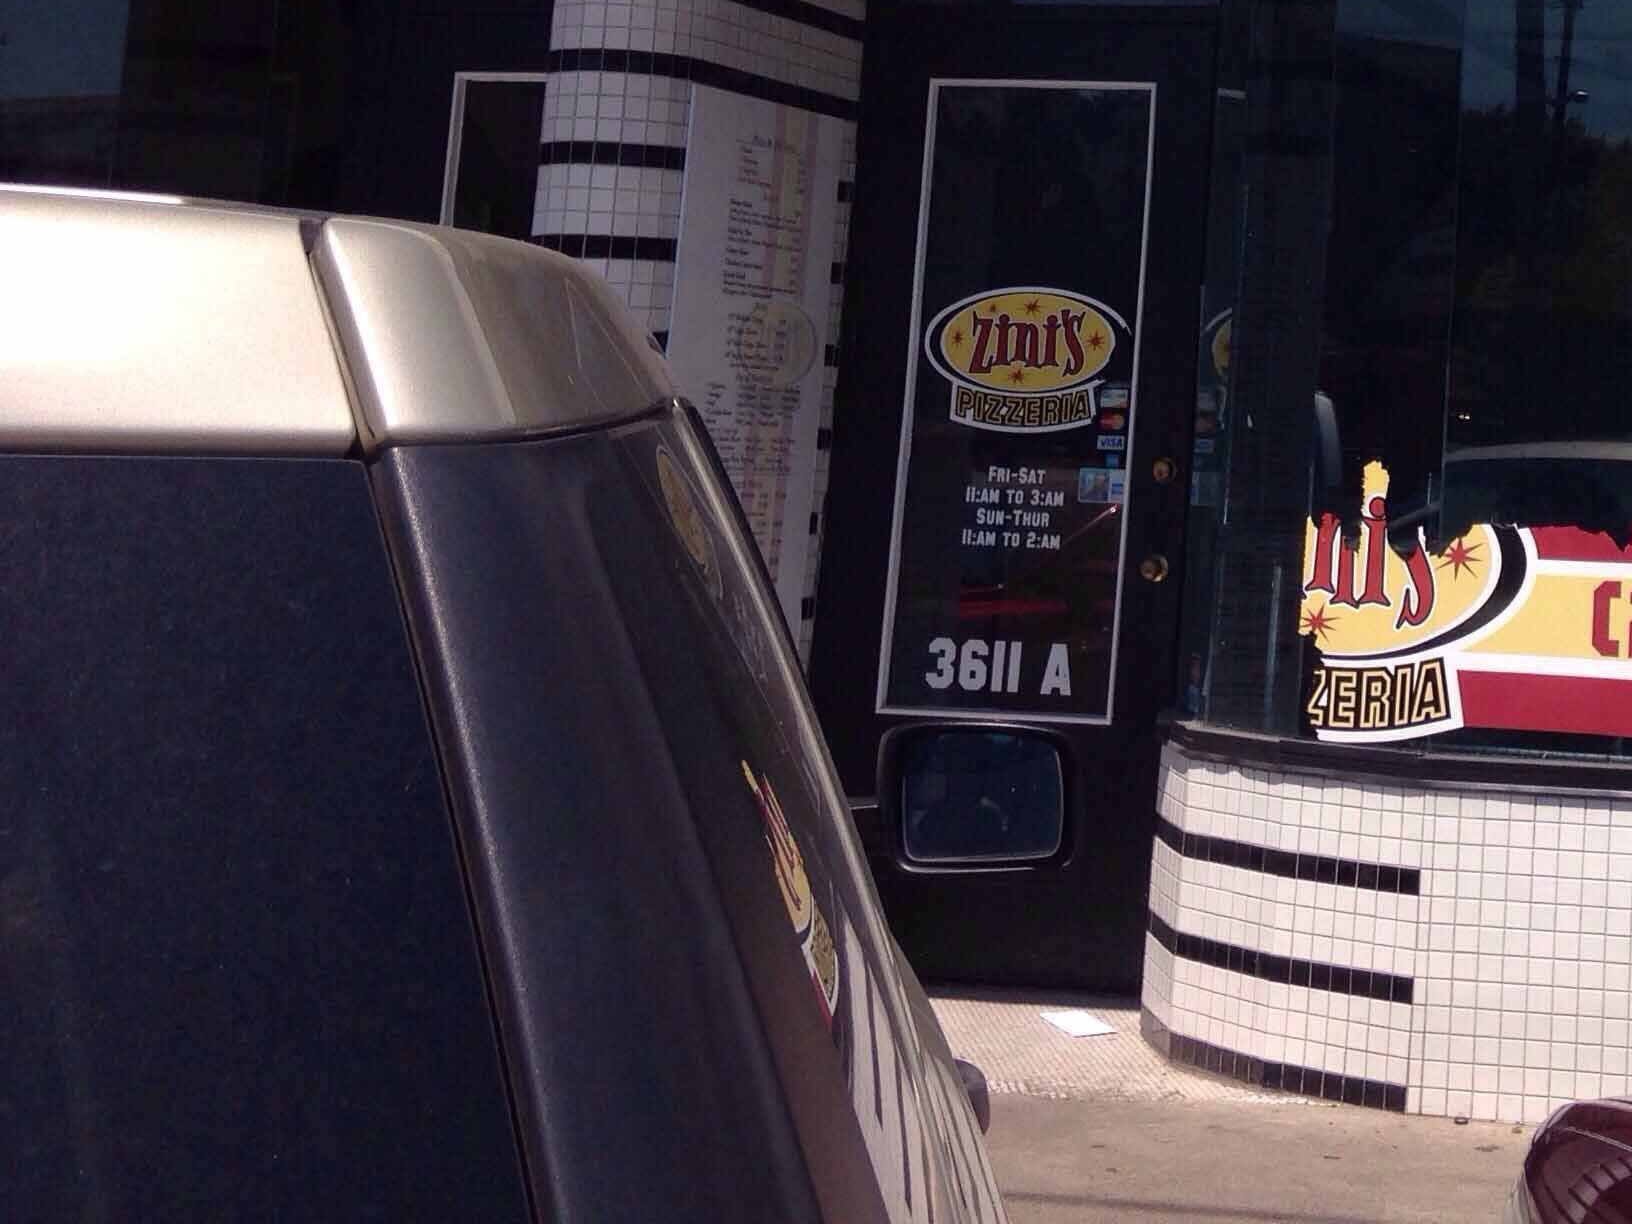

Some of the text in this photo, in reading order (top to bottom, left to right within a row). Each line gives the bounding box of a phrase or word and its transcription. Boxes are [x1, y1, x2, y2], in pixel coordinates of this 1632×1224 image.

[956, 387, 1093, 428] PIZZERIA
[988, 465, 1047, 485] FRI-SAT
[965, 486, 1064, 507] 11:AM TO 3:AM
[976, 507, 1050, 528] SUN-THUR
[962, 528, 1061, 550] 11:AM TO 2:AM
[925, 636, 1072, 696] 3611 A
